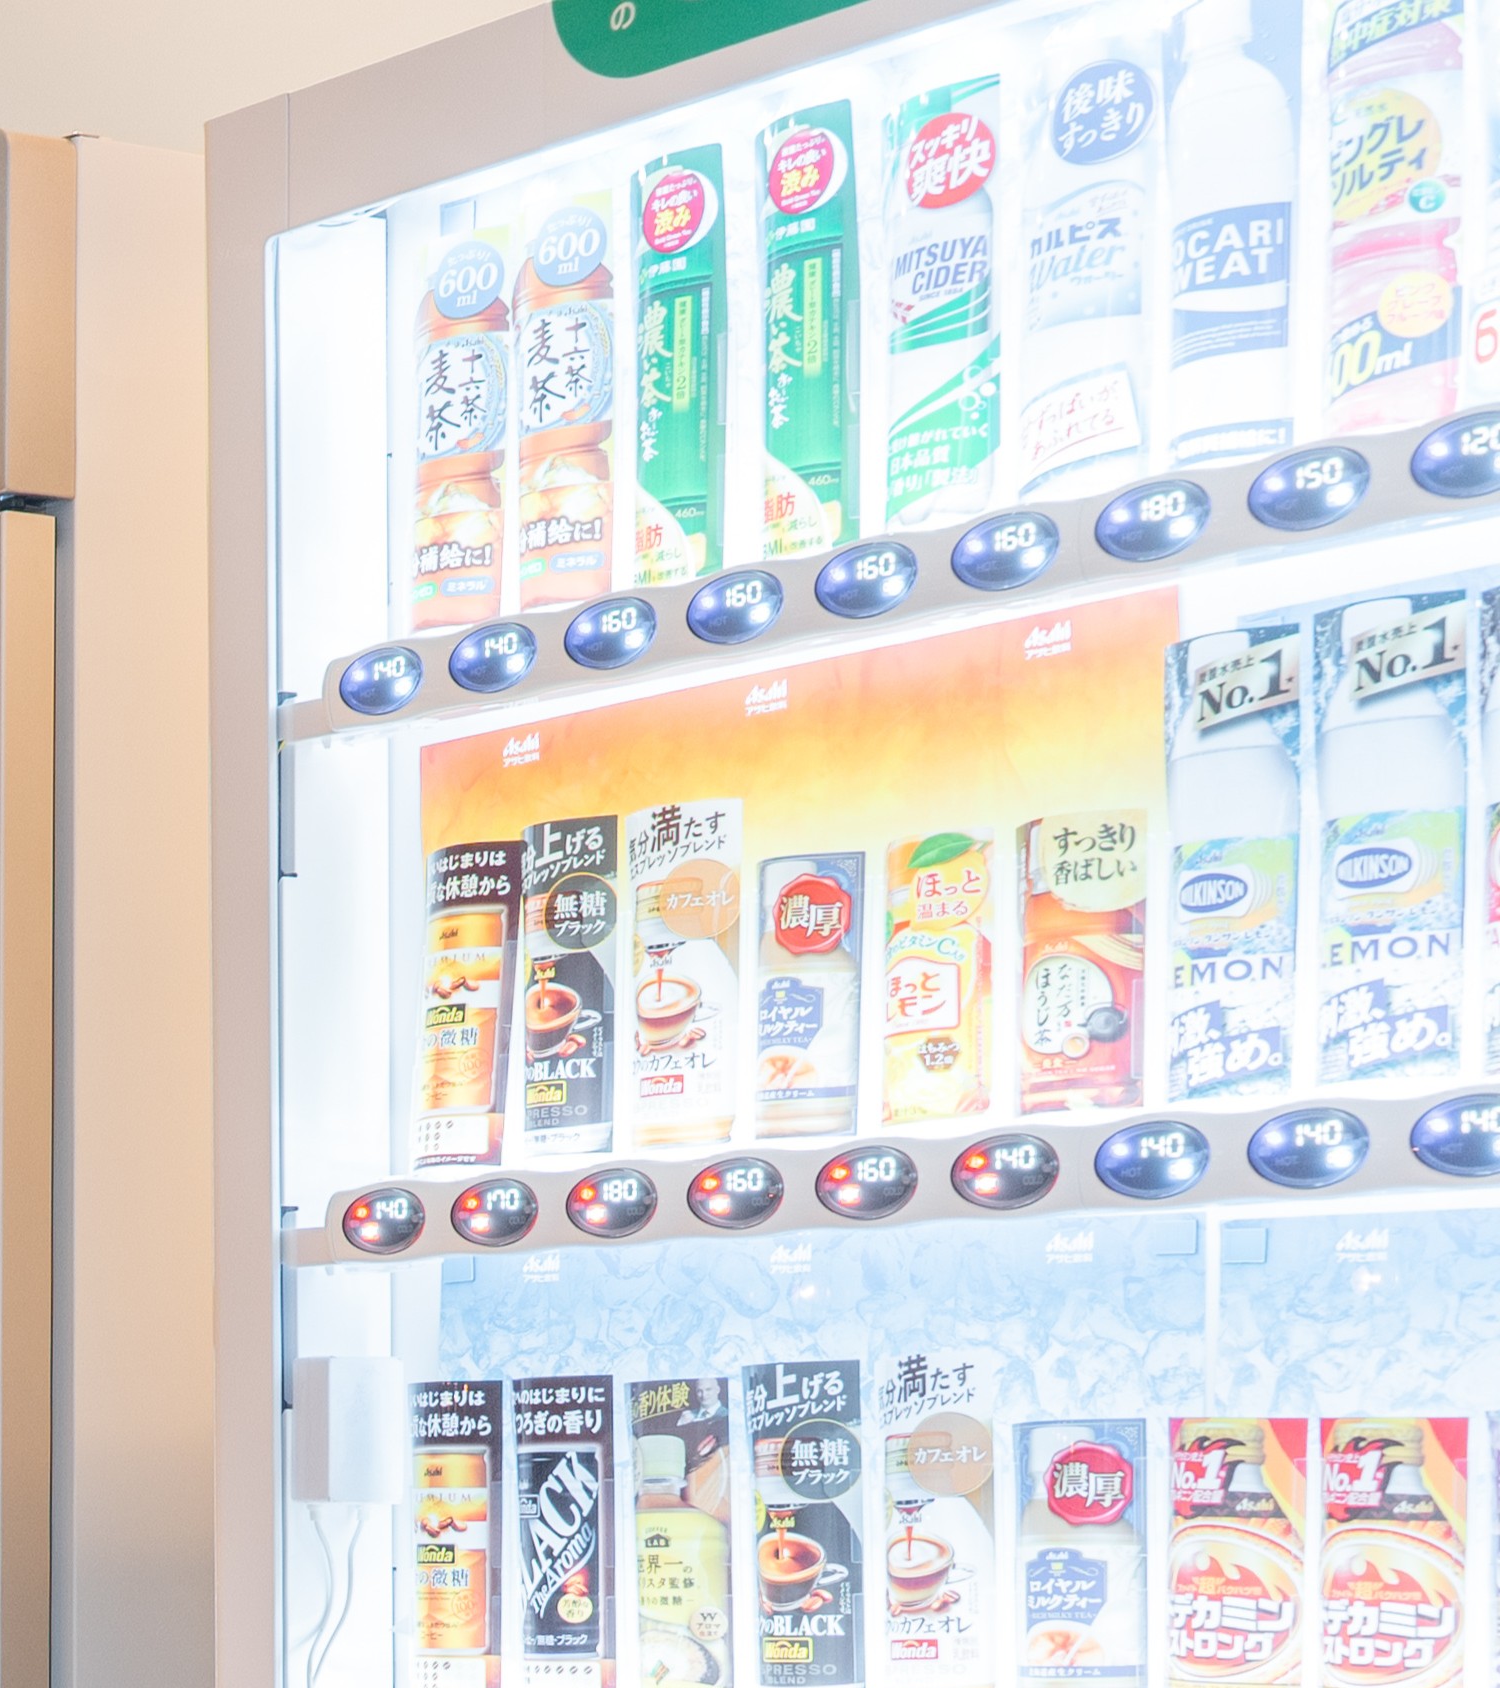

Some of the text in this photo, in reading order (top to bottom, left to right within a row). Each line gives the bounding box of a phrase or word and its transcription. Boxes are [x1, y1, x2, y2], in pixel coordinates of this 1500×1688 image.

[610, 1, 636, 31] の
[1060, 69, 1137, 122] 後味
[910, 115, 980, 163] スッキリ
[1058, 108, 1148, 156] すっきり
[780, 165, 820, 196] 渋み
[910, 139, 992, 205] 爽快
[653, 206, 692, 236] 渋み
[537, 230, 600, 265] 600
[894, 233, 989, 281] MITSUYA
[556, 257, 580, 276] ml
[911, 259, 988, 296] CIDER
[438, 264, 498, 300] 600
[455, 290, 477, 308] ml
[527, 318, 566, 423] 麦茶
[561, 316, 593, 398] 十六茶
[424, 348, 462, 451] 麦茶
[457, 348, 487, 428] 十六茶
[1295, 457, 1344, 489] 150
[1139, 491, 1186, 521] 180
[993, 521, 1034, 551] 160
[856, 552, 896, 580] 160
[725, 580, 763, 608] 160
[601, 606, 637, 634] 160
[483, 632, 518, 658] 140
[1353, 615, 1453, 693] No.1
[373, 655, 406, 680] 140
[1196, 647, 1287, 725] No.1
[1052, 821, 1137, 858] すっきり
[916, 869, 982, 899] ほっと
[1053, 854, 1138, 887] 香ばしい
[553, 892, 608, 920] 無糖
[666, 890, 735, 910] カフェオレ
[780, 893, 843, 937] 濃厚
[917, 901, 969, 920] 温まる
[554, 918, 606, 937] ブラック
[1034, 967, 1052, 1047] ほうじ茶
[1347, 1011, 1452, 1070] 強め。
[1187, 1028, 1282, 1086] 強め。
[1139, 1133, 1185, 1158] 140
[1295, 1120, 1343, 1147] 140
[857, 1157, 897, 1182] 160
[994, 1145, 1035, 1170] 140
[602, 1179, 638, 1202] 180
[725, 1169, 763, 1192] 160
[375, 1198, 408, 1220] 140
[791, 1439, 850, 1468] 無糖
[915, 1445, 987, 1465] カフェオレ
[792, 1467, 850, 1485] ブラック
[1052, 1461, 1126, 1508] 濃厚
[1325, 1450, 1384, 1493] No.1
[1028, 1577, 1096, 1595] ロイヤル
[1026, 1594, 1102, 1612] ミルクティー
[764, 1640, 809, 1661] Wonda
[891, 1640, 935, 1660] Wonda
